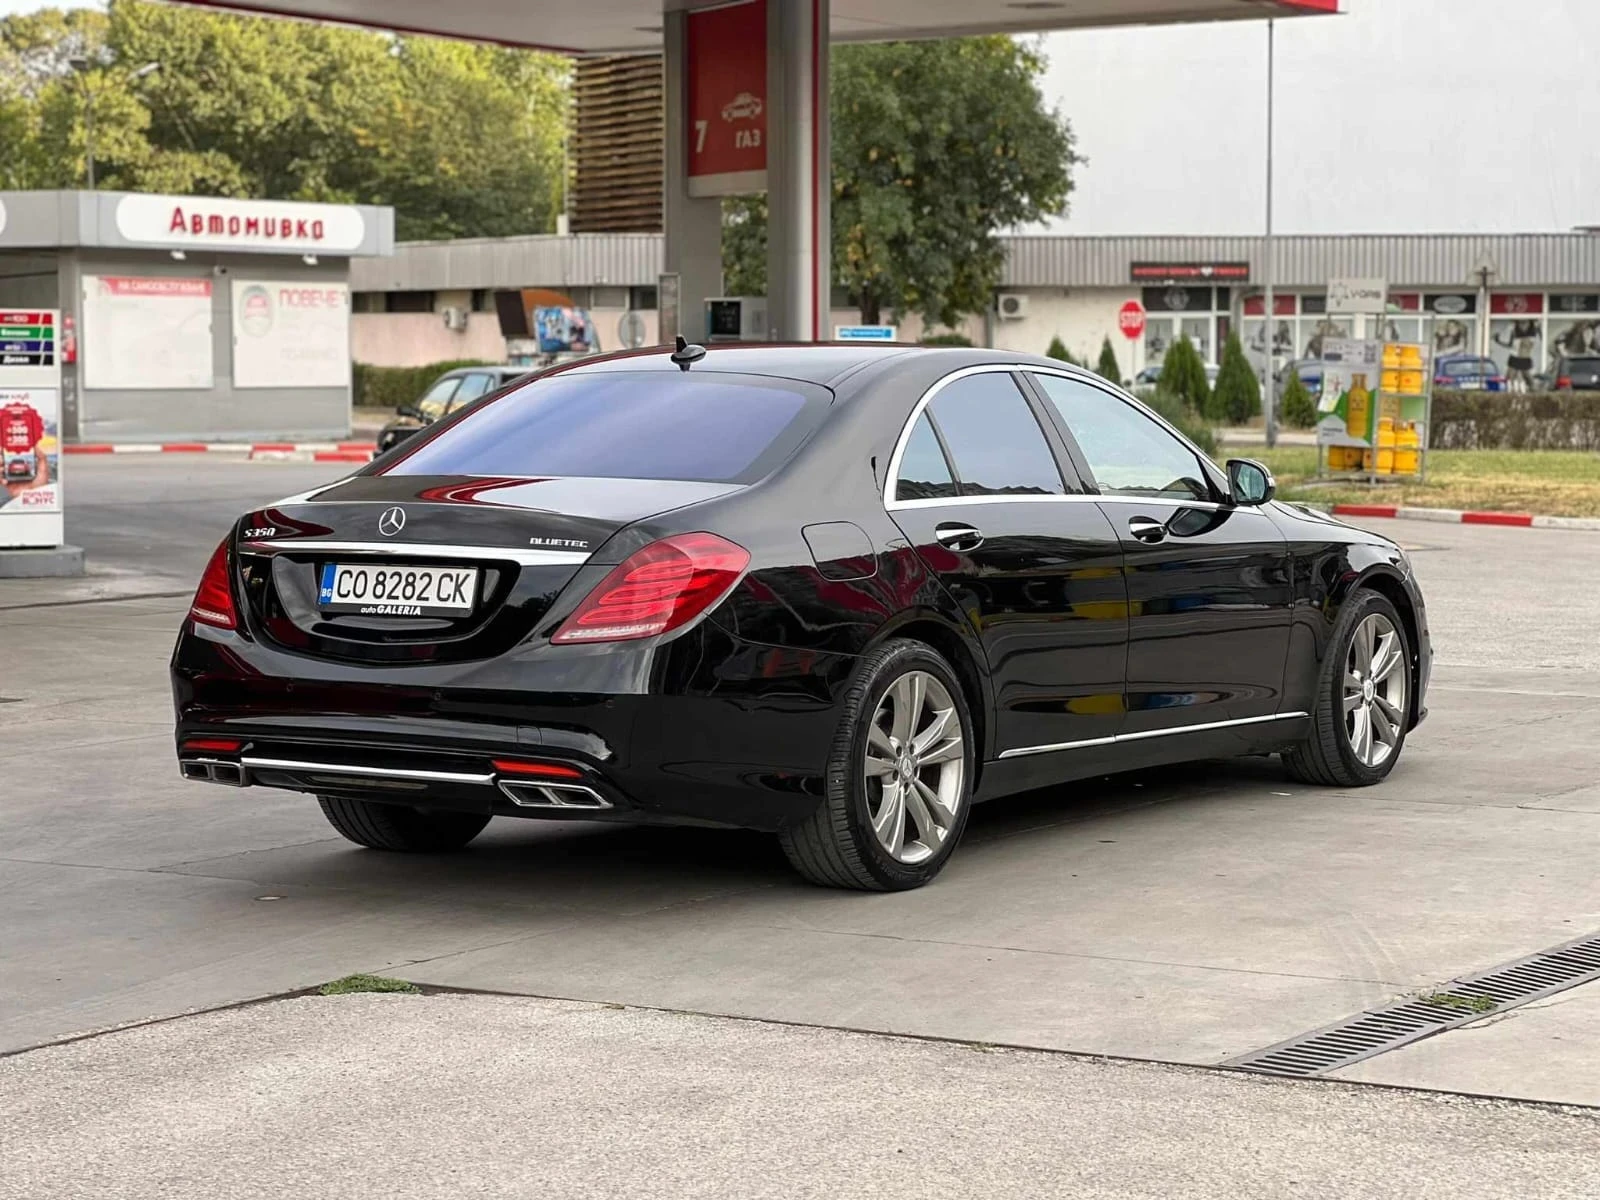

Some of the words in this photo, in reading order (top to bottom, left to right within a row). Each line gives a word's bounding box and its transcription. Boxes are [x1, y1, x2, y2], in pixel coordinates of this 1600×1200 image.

[695, 120, 708, 153] 7
[735, 129, 761, 149] ГАЗ
[169, 206, 325, 241] Автомивка
[279, 288, 340, 309] ПОВЕЧЕ
[1120, 311, 1144, 329] STOP
[244, 527, 276, 538] S350
[529, 537, 588, 549] BLUETEC
[322, 587, 332, 597] BG
[372, 573, 432, 602] 8282
